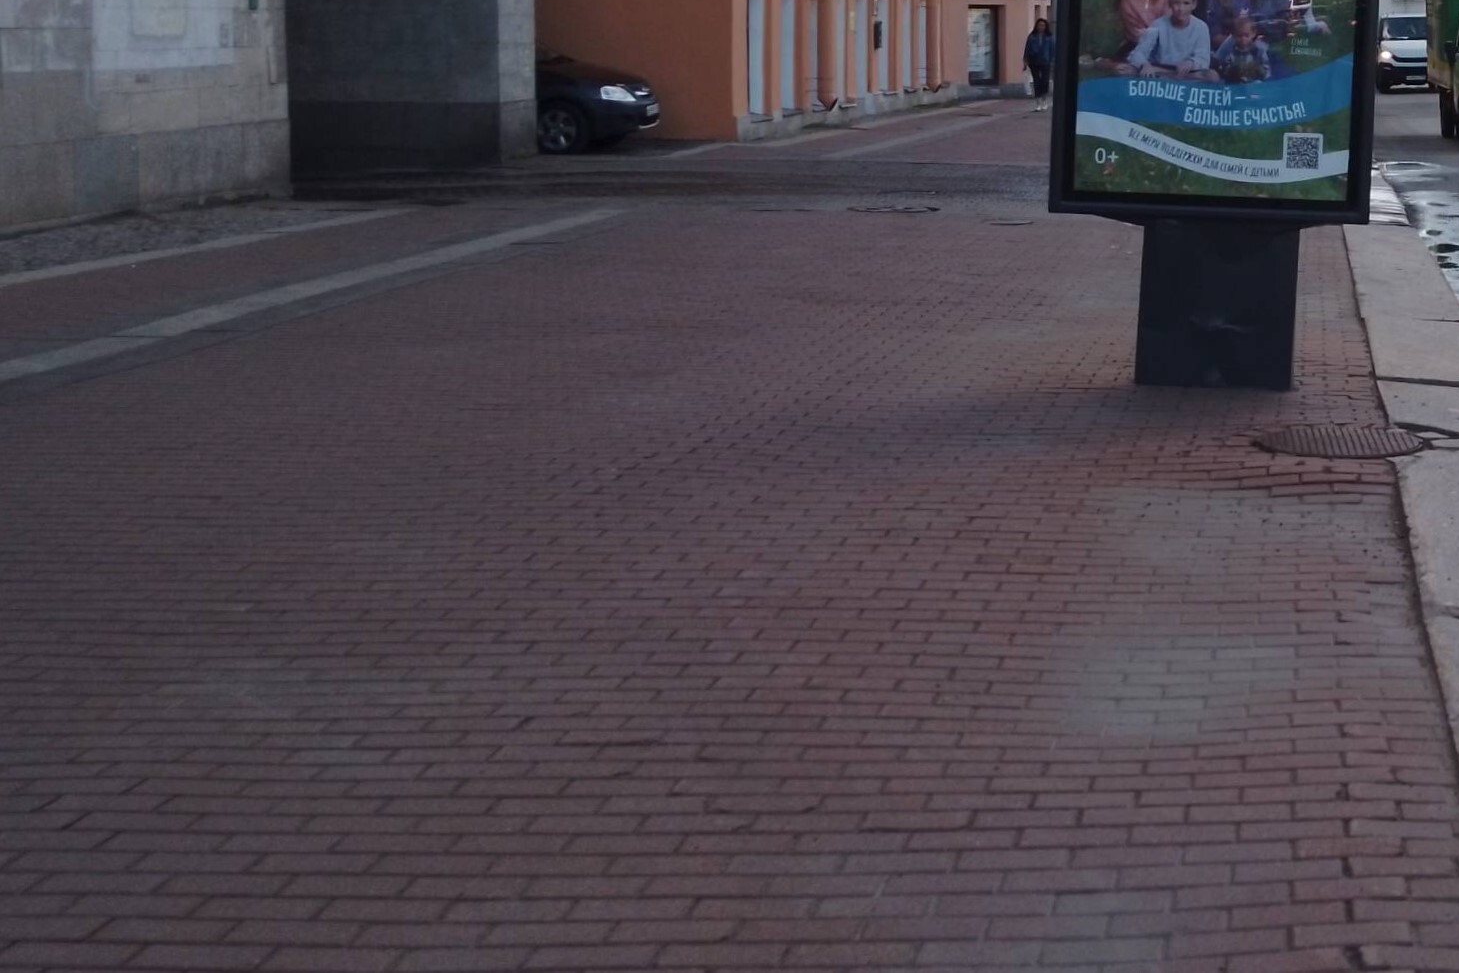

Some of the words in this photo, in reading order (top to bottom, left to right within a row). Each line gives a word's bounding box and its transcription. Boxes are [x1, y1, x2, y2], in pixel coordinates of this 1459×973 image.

[1129, 80, 1185, 102] БОЛЬШЕ
[1187, 87, 1232, 106] ДЕТЕЙ
[1183, 107, 1241, 126] БОЛЬШЕ
[1243, 101, 1307, 125] СЧАСТЬЯ!
[1094, 147, 1119, 164] 0+
